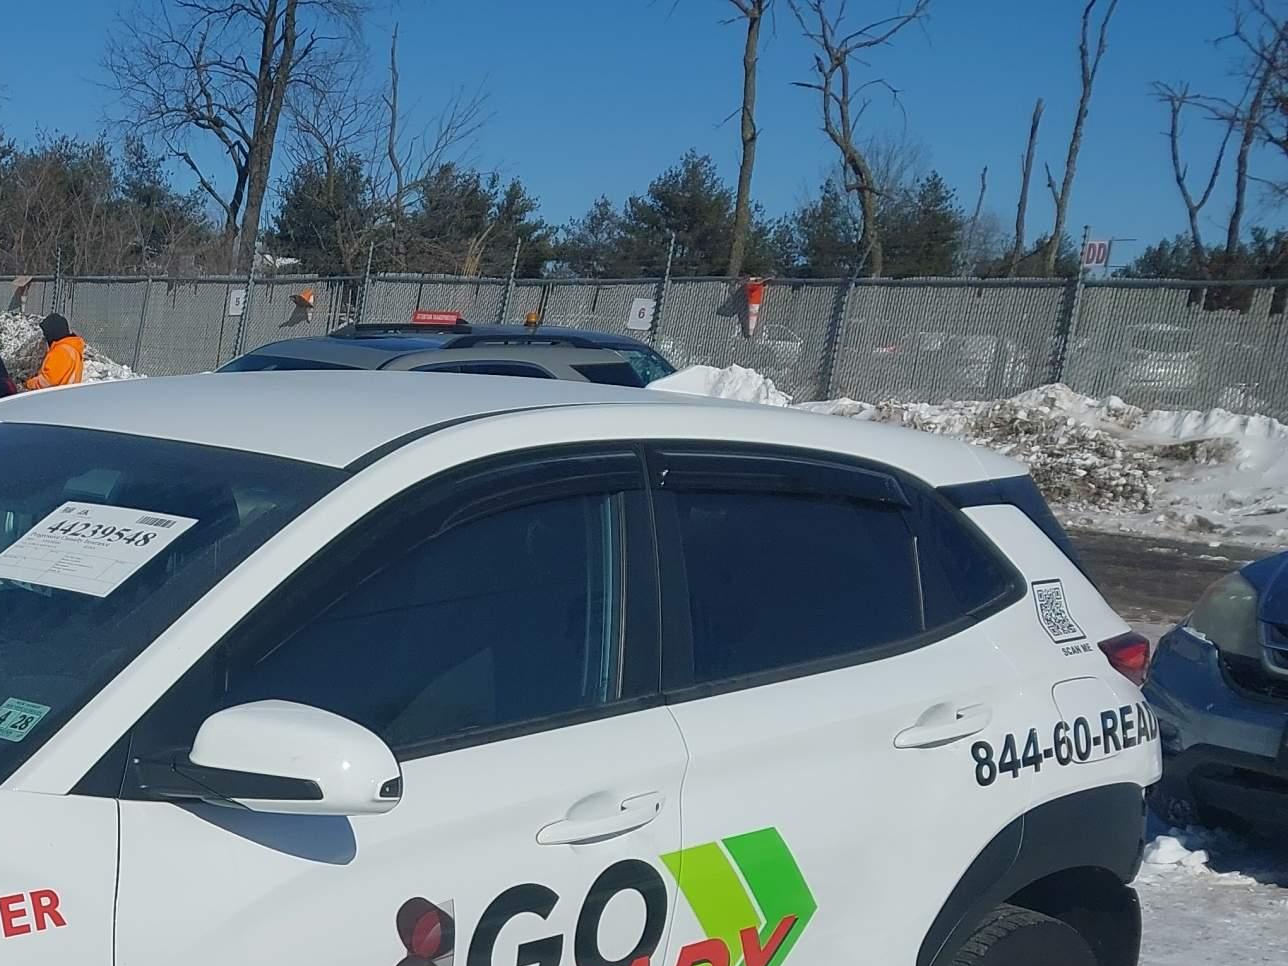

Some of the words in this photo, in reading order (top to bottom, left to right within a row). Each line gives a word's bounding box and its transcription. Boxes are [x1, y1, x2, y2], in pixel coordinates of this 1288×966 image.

[235, 297, 241, 306] 5
[638, 307, 646, 319] 6
[47, 519, 158, 548] 44239548
[10, 714, 35, 731] 28
